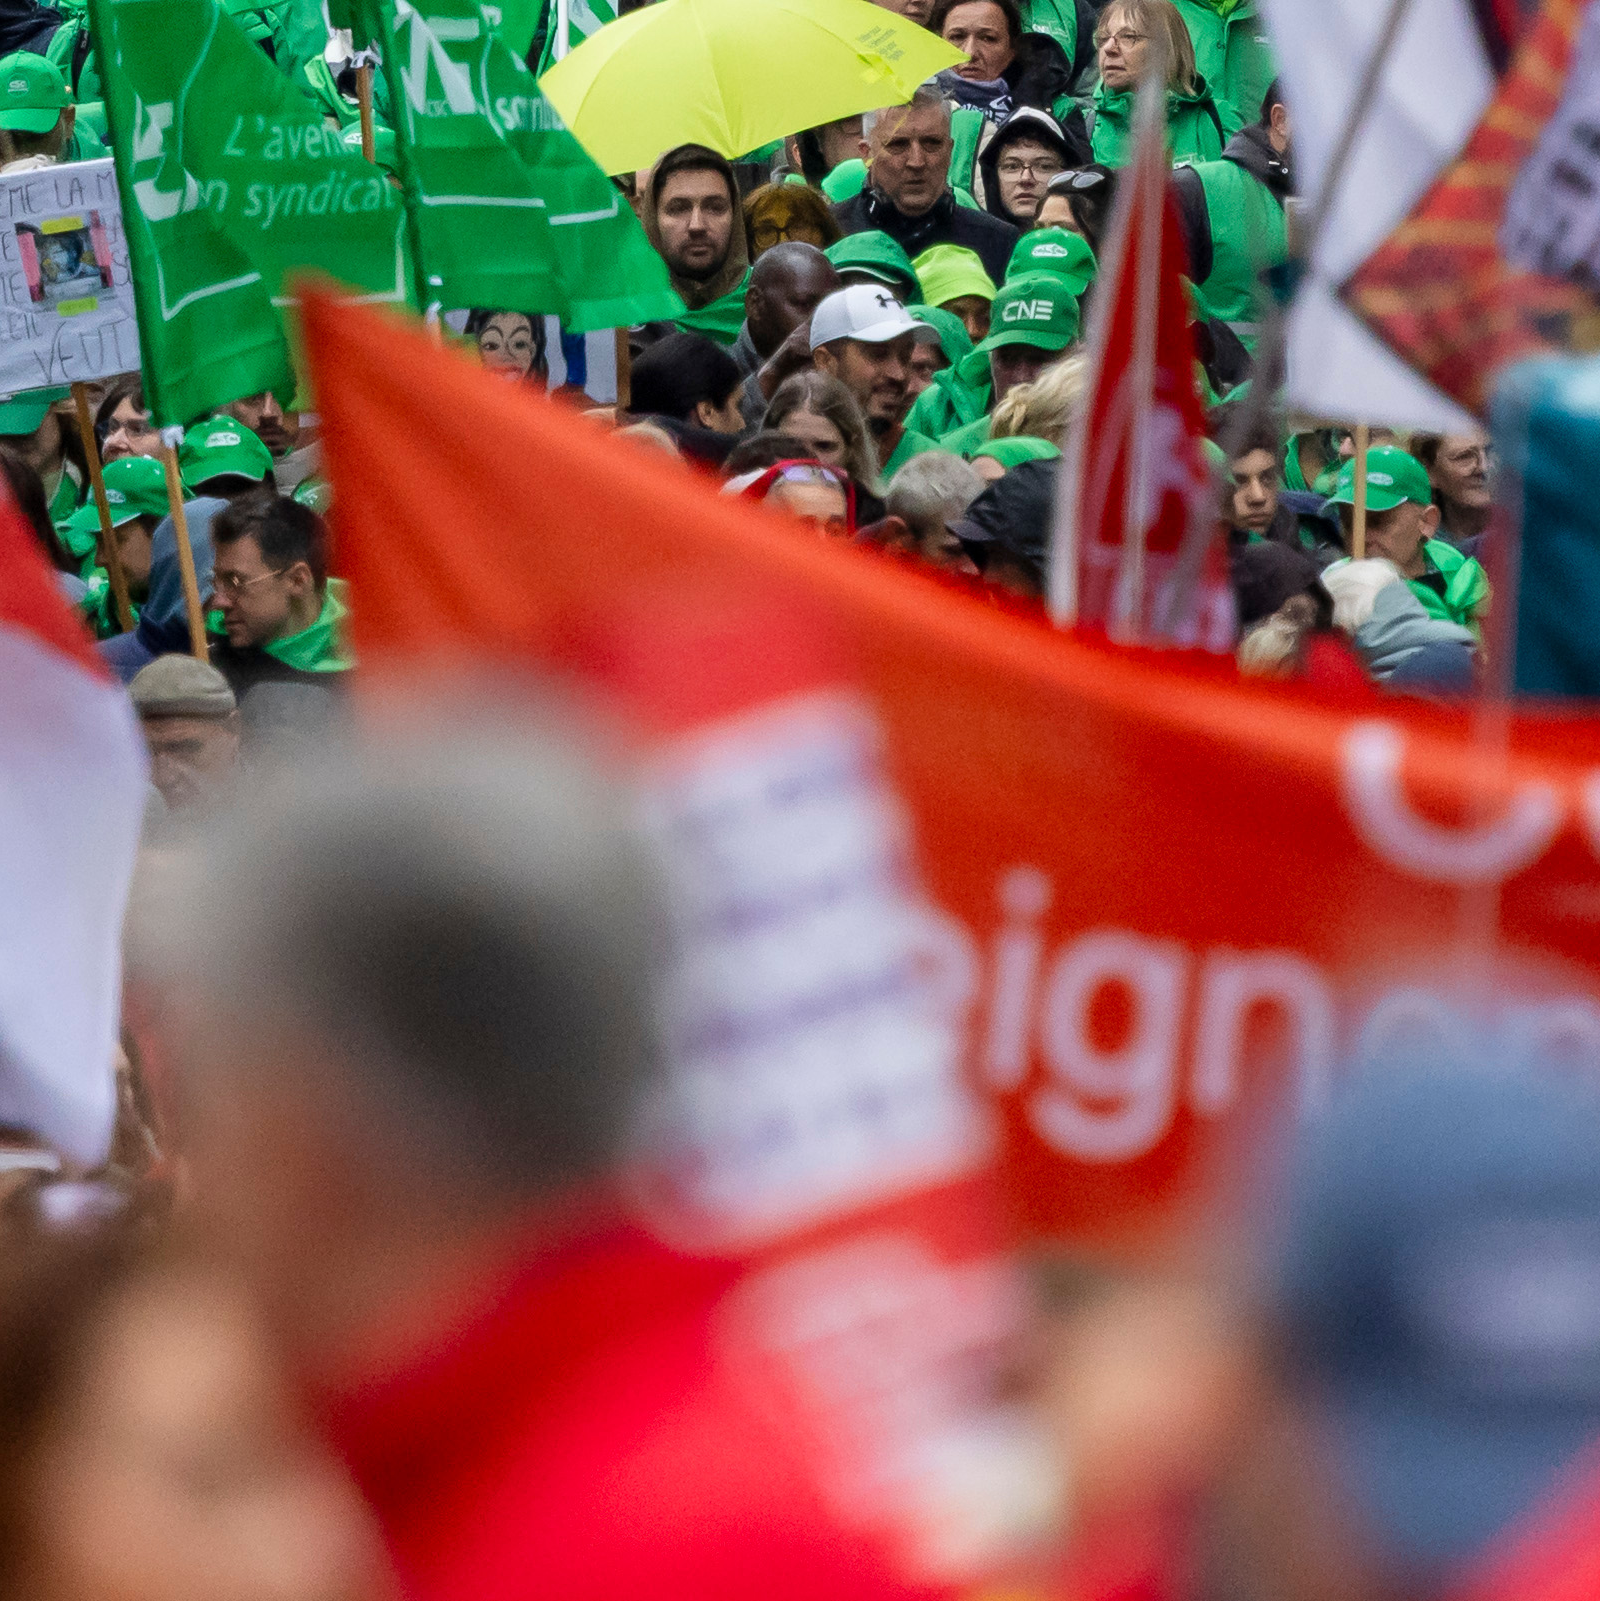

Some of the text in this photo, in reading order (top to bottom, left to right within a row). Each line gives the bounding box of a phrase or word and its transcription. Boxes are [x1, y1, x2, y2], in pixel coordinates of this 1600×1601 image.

[55, 177, 86, 209] LA
[244, 170, 396, 231] syndicat
[1002, 299, 1054, 322] CNE
[33, 315, 131, 385] VEUT
